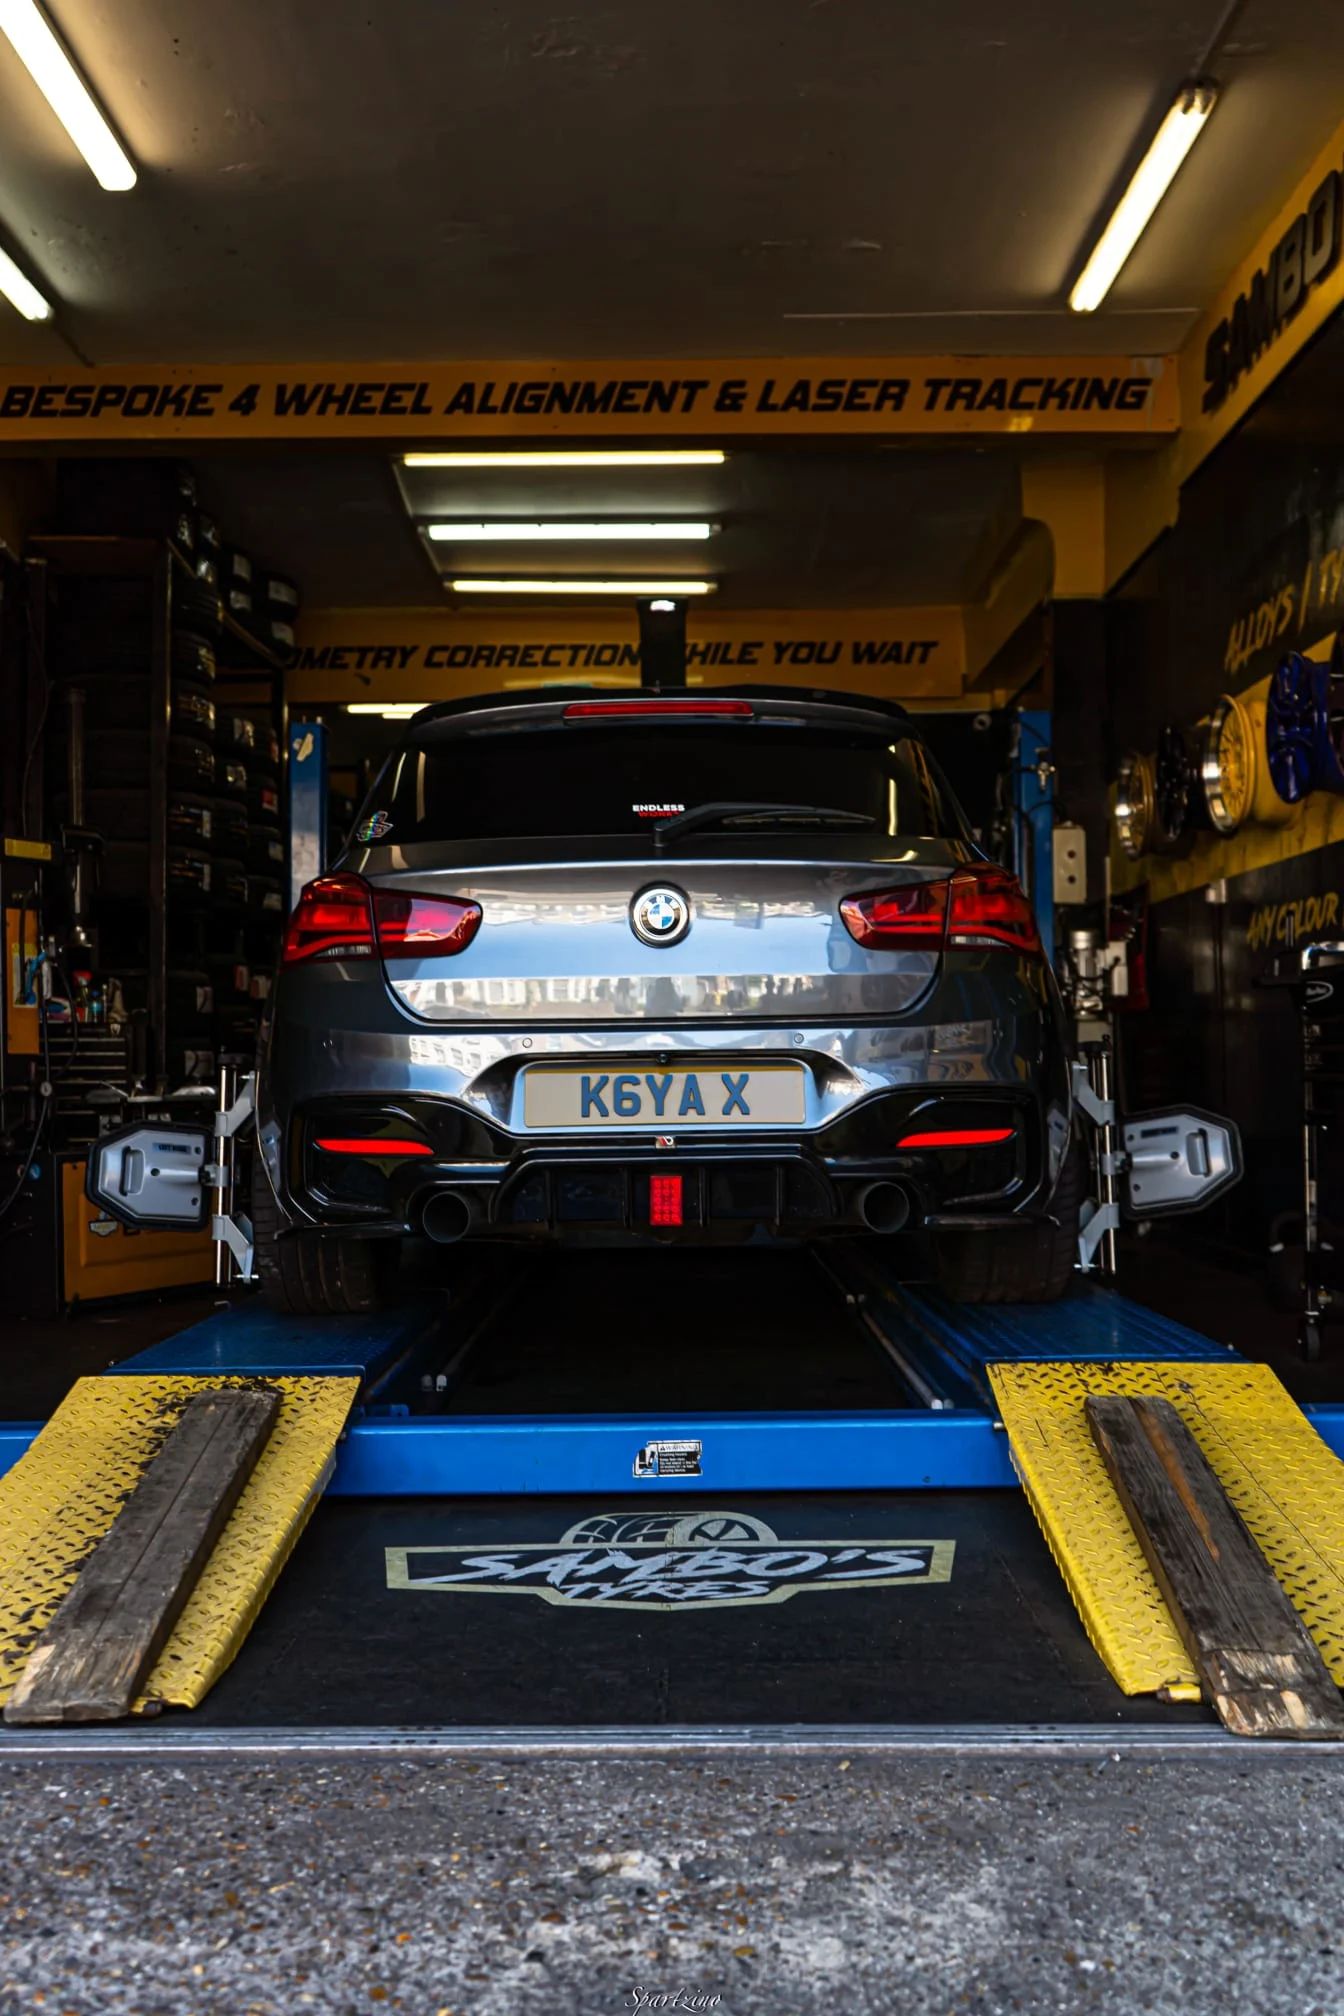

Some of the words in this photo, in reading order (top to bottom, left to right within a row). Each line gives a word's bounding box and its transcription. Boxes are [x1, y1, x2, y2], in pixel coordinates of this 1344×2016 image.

[0, 384, 223, 418] BESPOKE
[229, 384, 260, 417] 4
[273, 383, 432, 416] WHEEL
[443, 381, 710, 415] ALIGNMENT
[714, 380, 747, 413] &
[755, 379, 909, 412] LASER
[924, 378, 1152, 411] TRACKING
[1224, 582, 1294, 676] ALLOYS
[424, 643, 643, 668] CORRECTION
[684, 642, 763, 666] HILE
[773, 641, 842, 665] YOU
[852, 641, 938, 665] WAIT
[632, 804, 685, 812] ENDLESS
[580, 1073, 706, 1118] K6YA
[721, 1073, 750, 1116] X
[408, 1547, 926, 1588] SAMBO'S
[559, 1580, 770, 1600] TYRES
